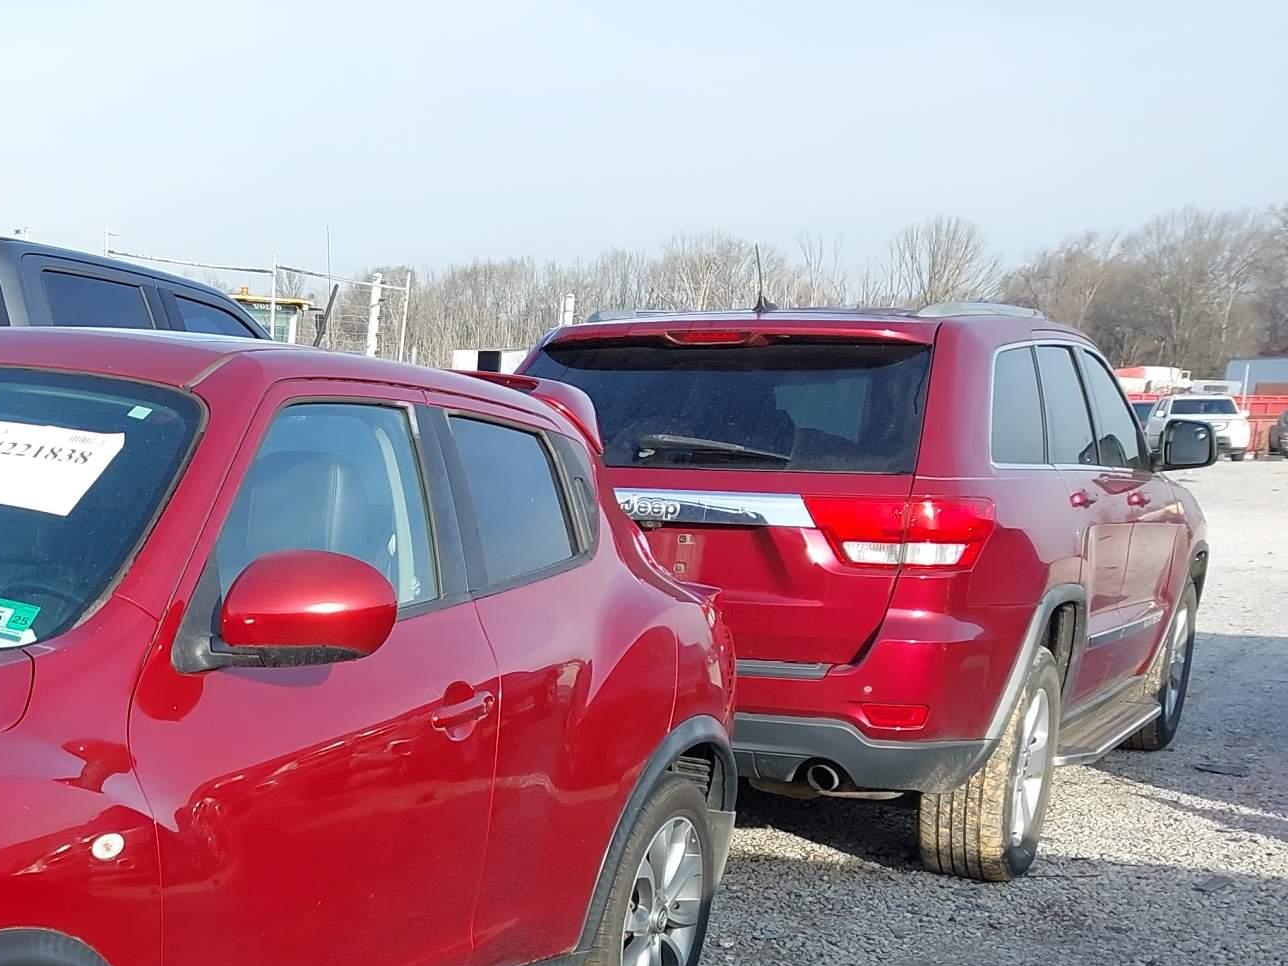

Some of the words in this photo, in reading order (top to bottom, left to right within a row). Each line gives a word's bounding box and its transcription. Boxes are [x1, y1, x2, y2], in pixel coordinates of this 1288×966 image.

[253, 303, 282, 311] VOLO
[620, 494, 681, 520] Jeep
[11, 615, 30, 626] 25
